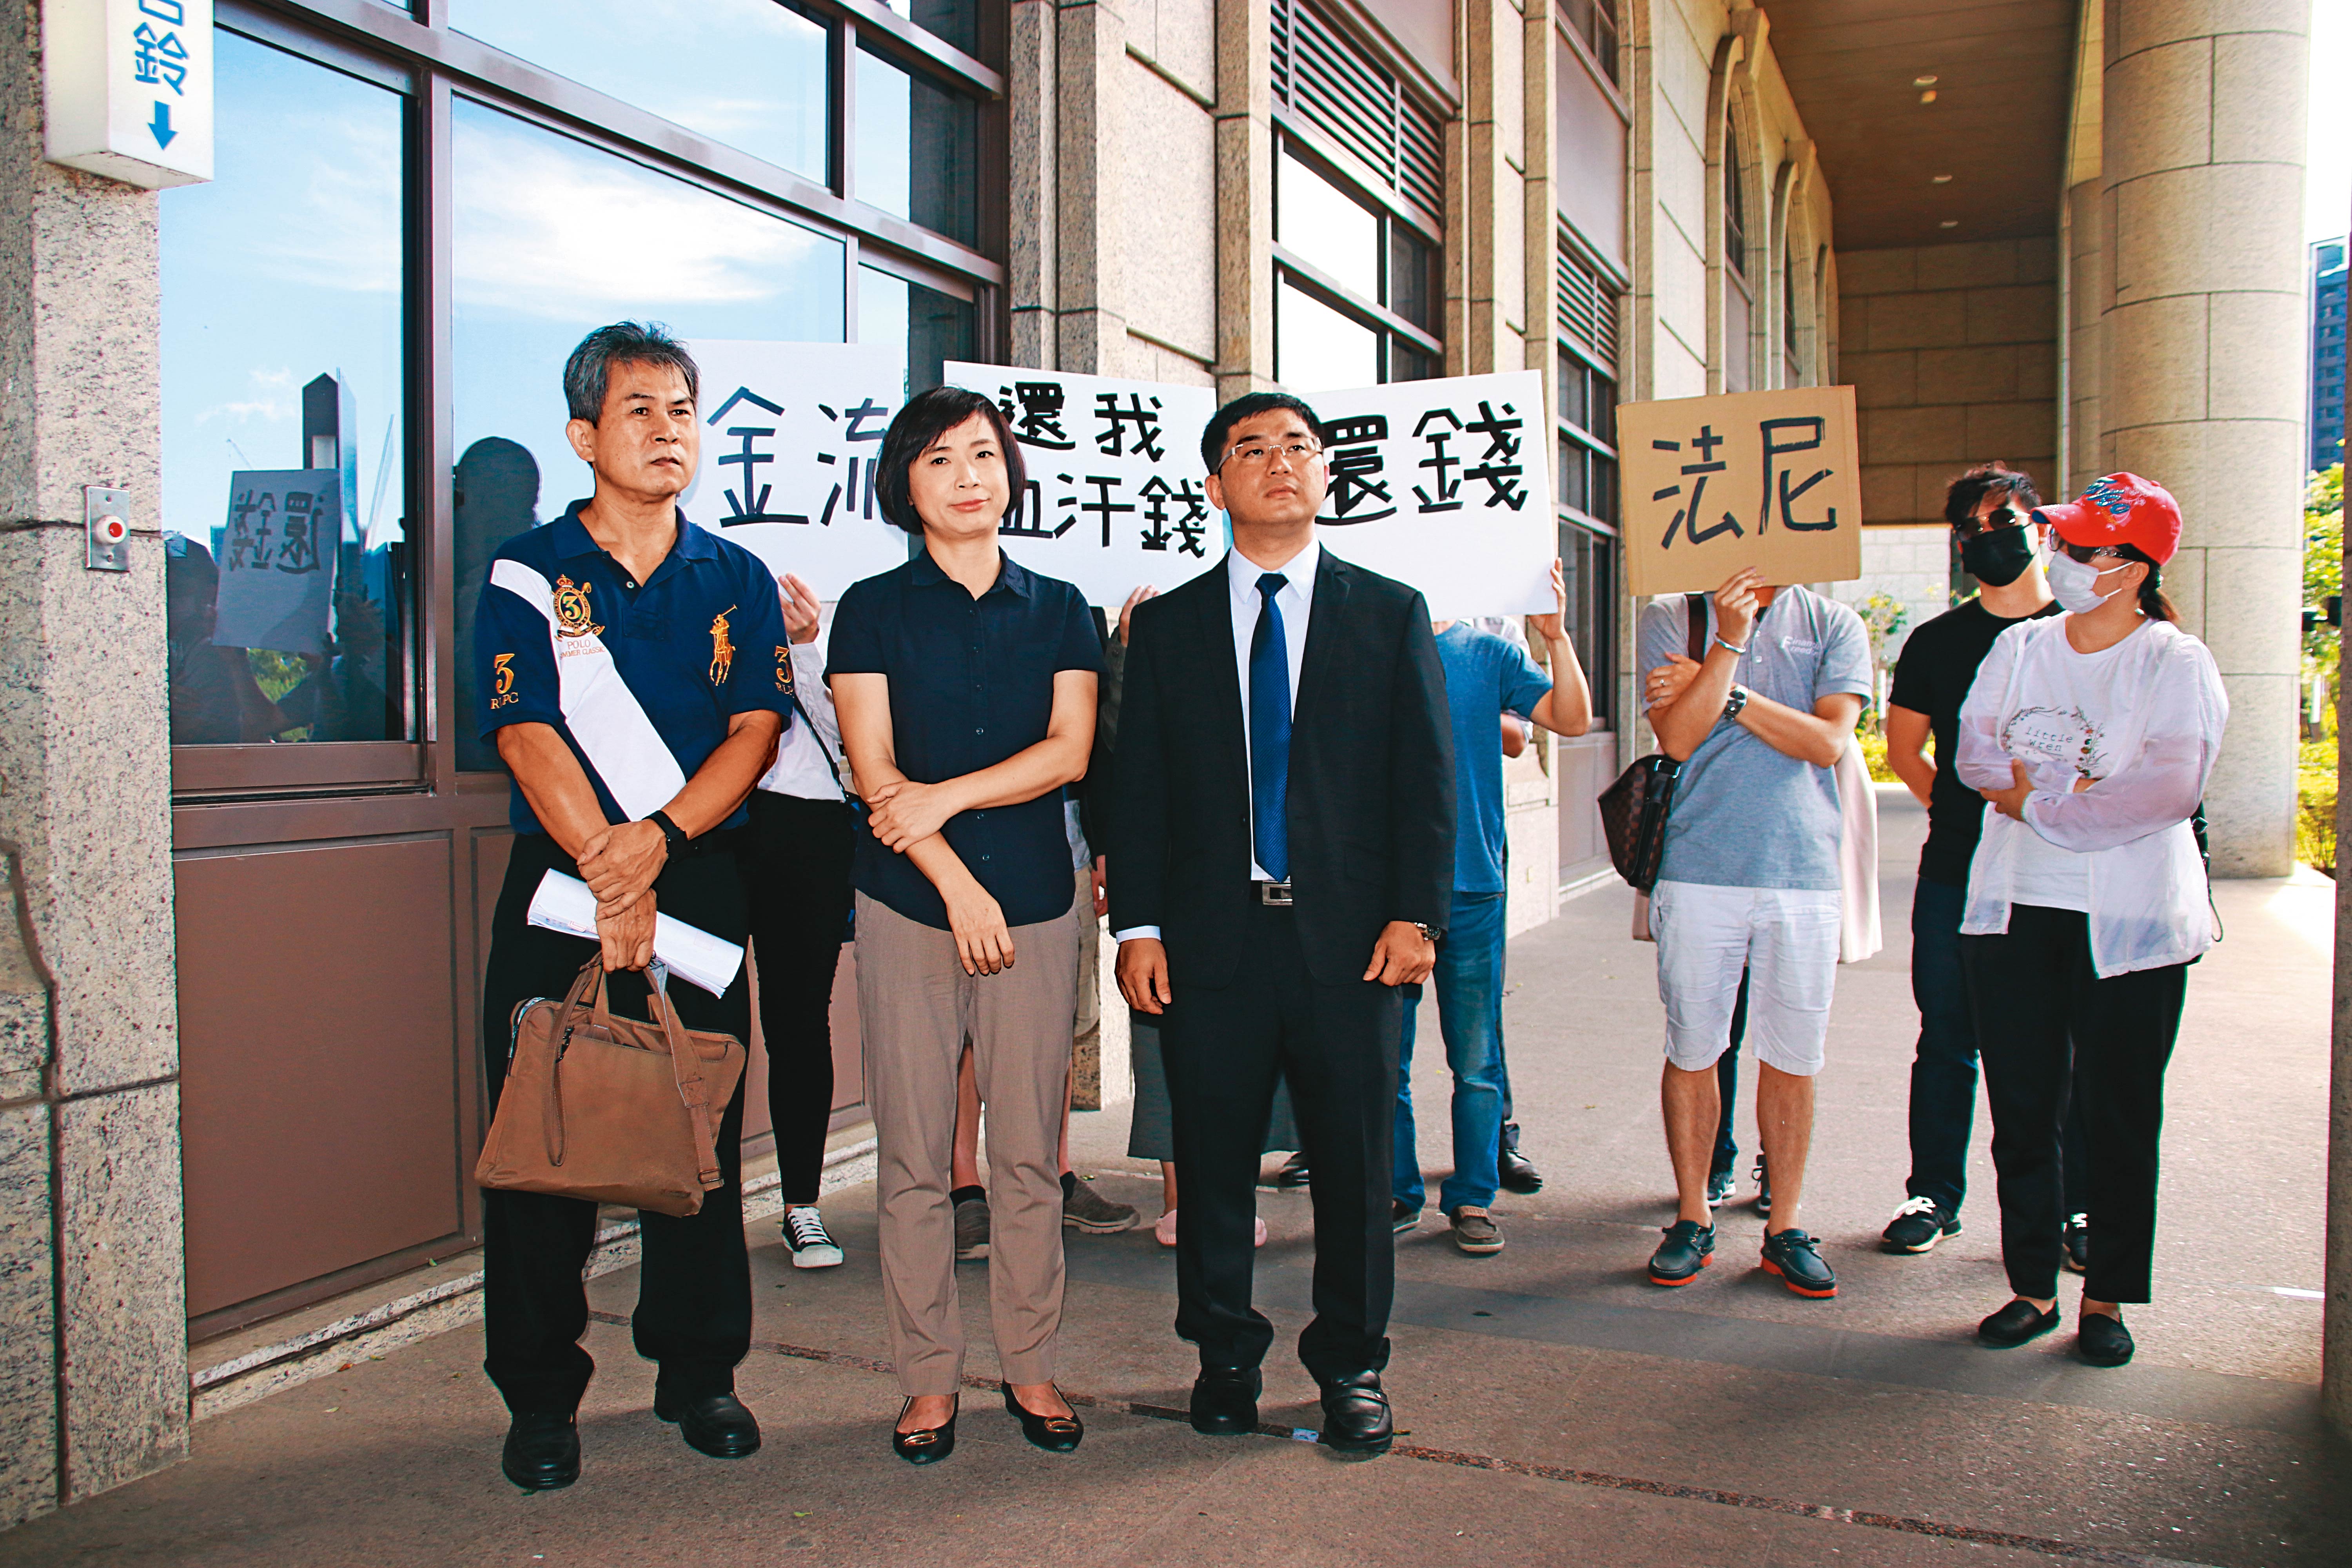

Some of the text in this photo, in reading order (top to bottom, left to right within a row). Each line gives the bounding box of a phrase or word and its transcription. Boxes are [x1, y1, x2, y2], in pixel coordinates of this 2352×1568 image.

[998, 381, 1165, 463] 還我
[707, 386, 888, 528] 金流
[1315, 401, 1529, 526] 還錢
[1652, 416, 1838, 550] 法尼
[563, 595, 581, 620] 3
[567, 639, 591, 650] POLO
[583, 646, 606, 655] CLASSIC
[494, 653, 515, 694] 3
[775, 645, 793, 683] 3
[2025, 726, 2073, 743] little
[2029, 739, 2062, 752] wren
